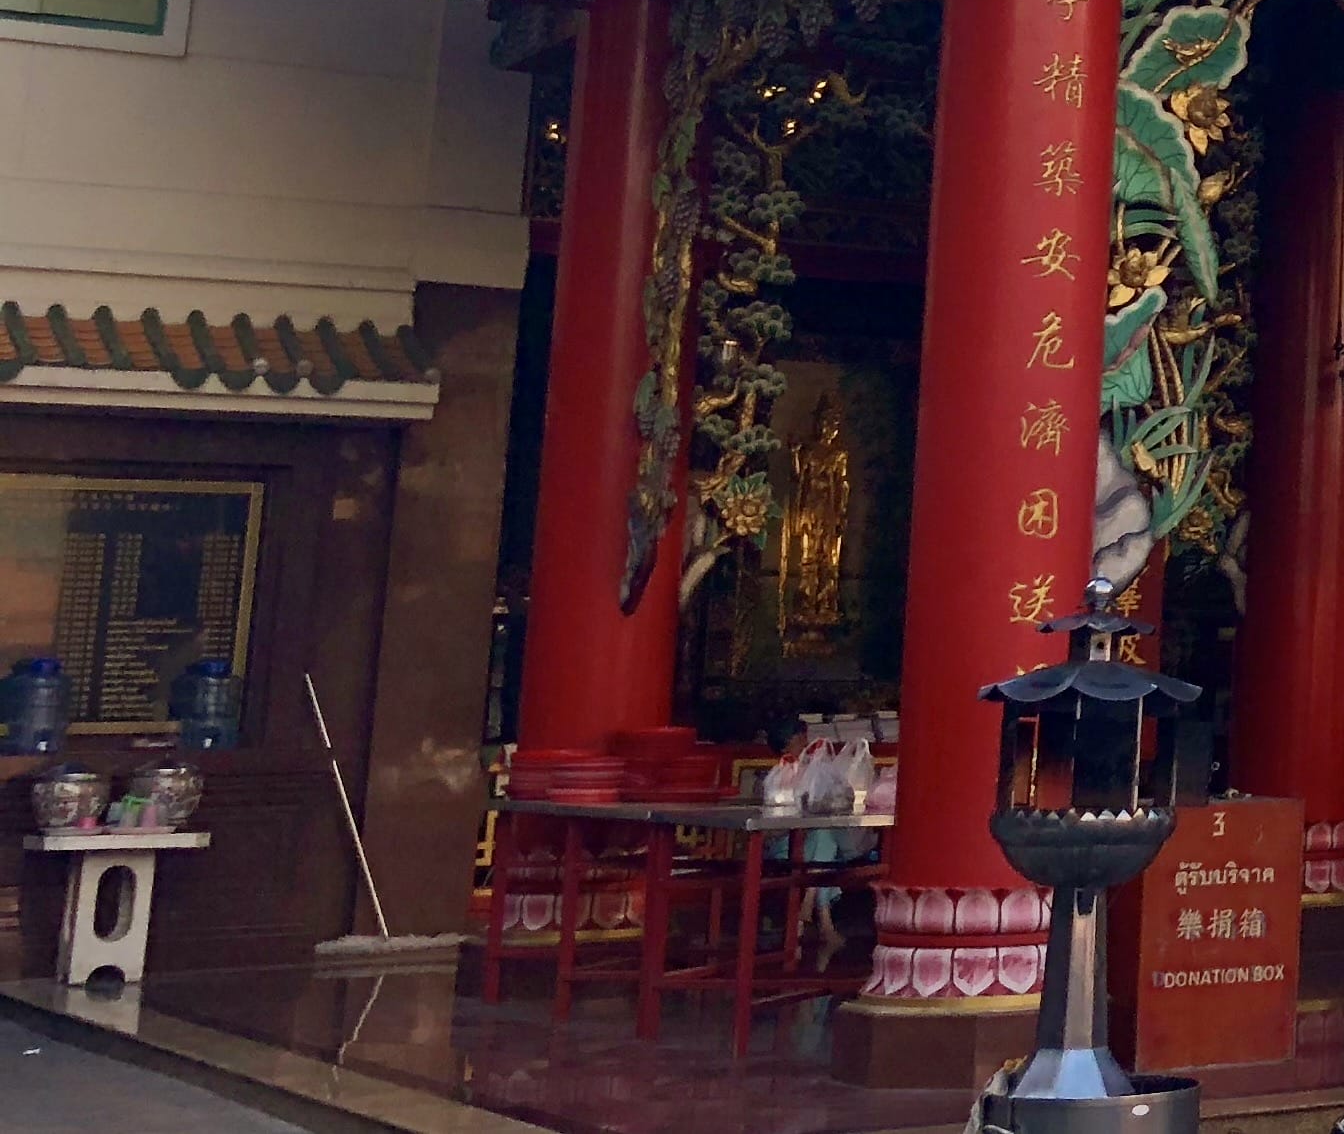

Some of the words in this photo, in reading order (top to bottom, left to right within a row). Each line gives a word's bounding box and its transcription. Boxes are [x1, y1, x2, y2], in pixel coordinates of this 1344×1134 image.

[1212, 812, 1226, 837] 3
[1175, 860, 1275, 895] ตู้รับบริจาค
[1177, 908, 1264, 939] 樂捐箱
[1164, 968, 1249, 988] DONATION
[1252, 965, 1285, 982] BOX
